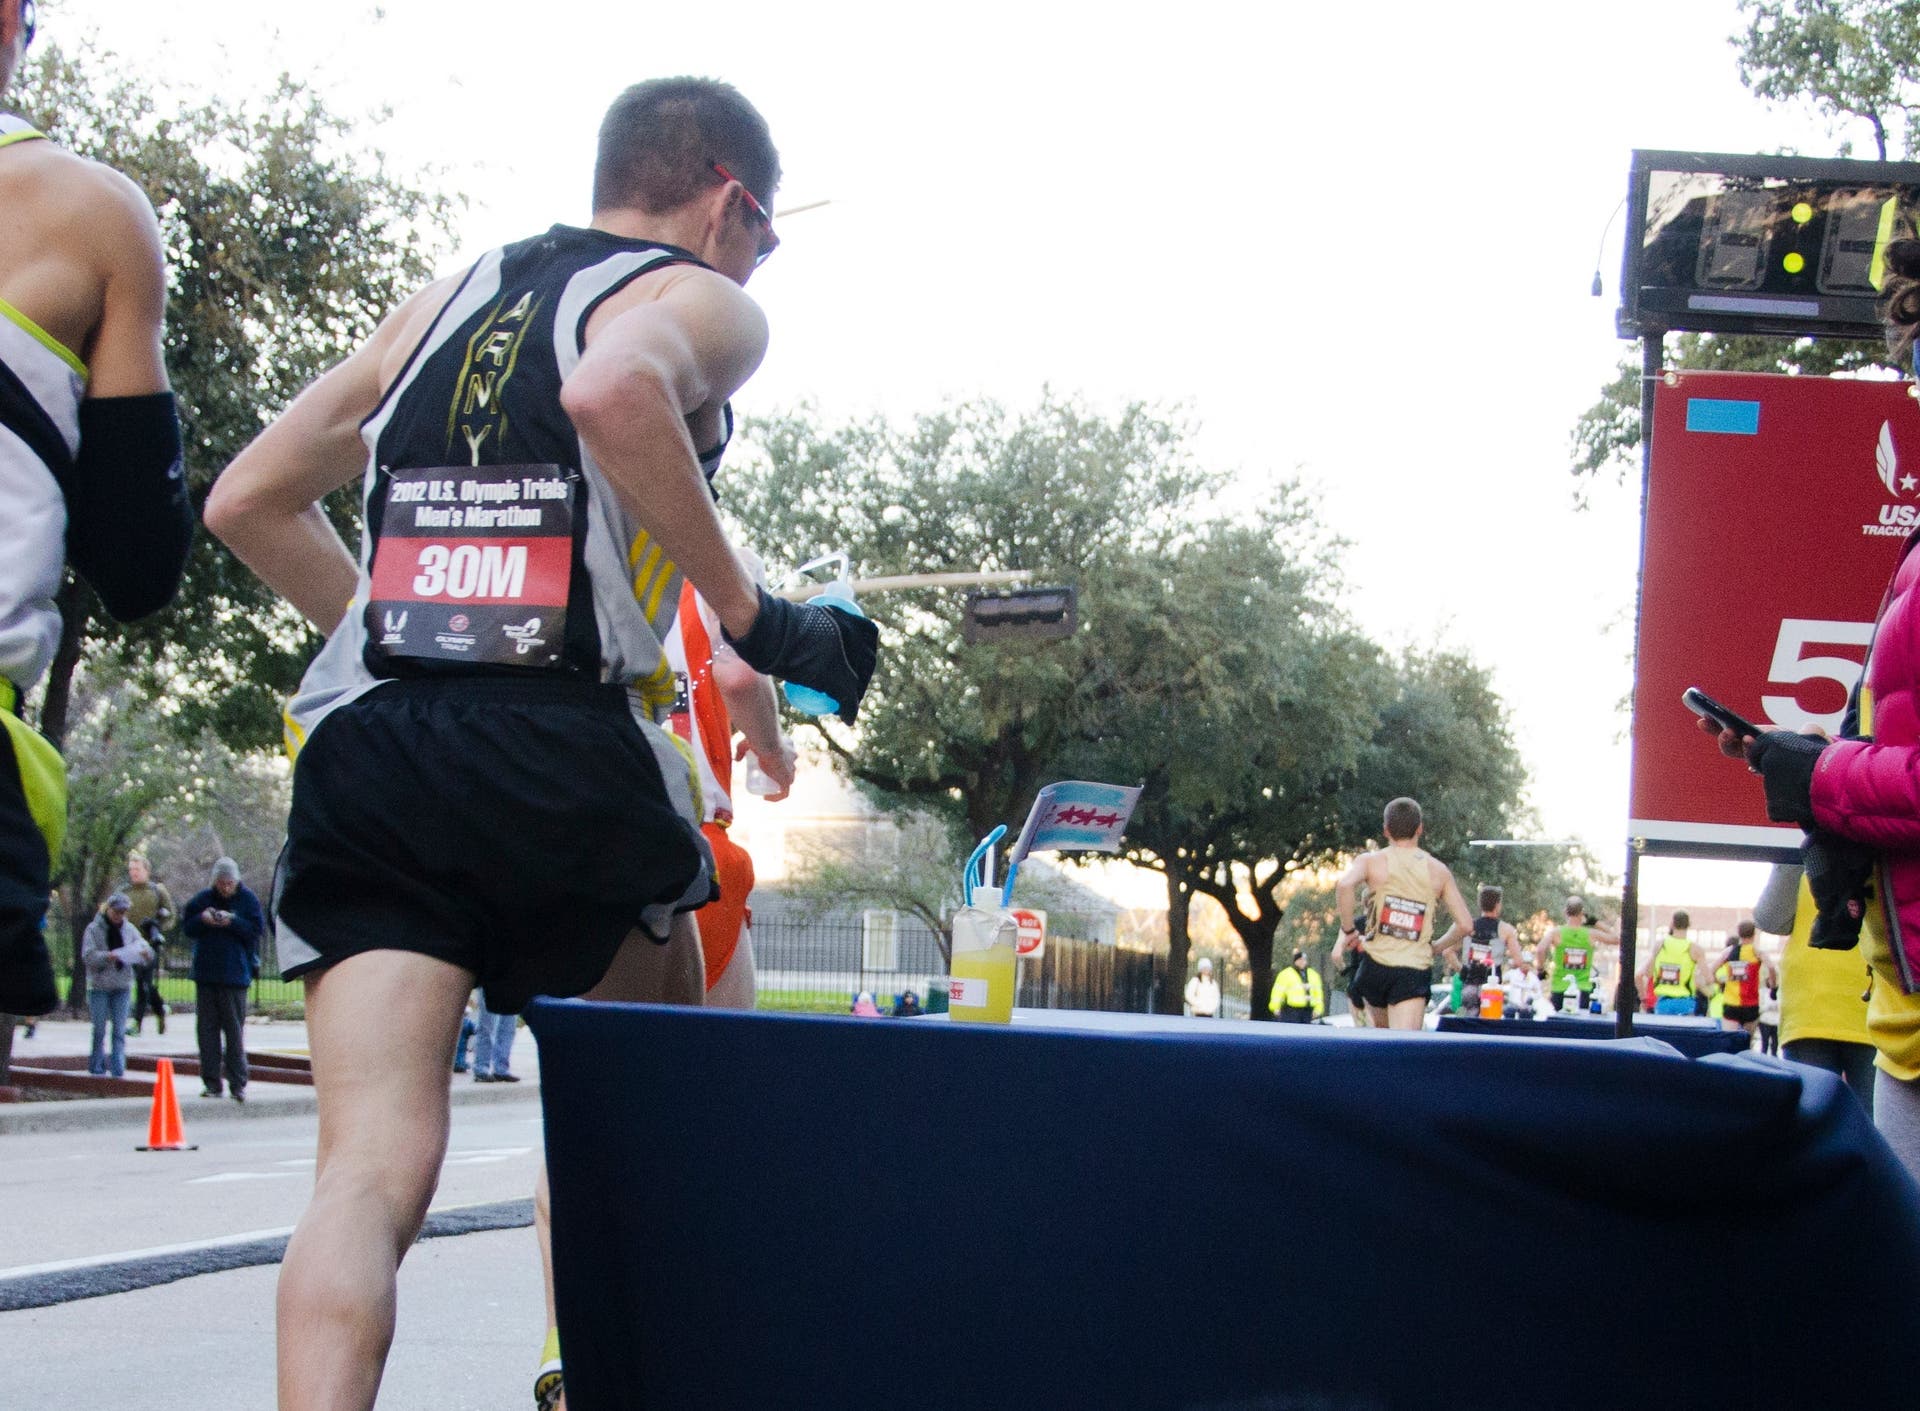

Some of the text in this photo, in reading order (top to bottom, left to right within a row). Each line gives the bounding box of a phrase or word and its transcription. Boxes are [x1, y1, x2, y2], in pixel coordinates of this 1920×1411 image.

[461, 290, 535, 467] ARMY
[390, 478, 568, 504] 2012 U.S. Olympic Trials
[415, 506, 542, 527] Men's Marathon
[412, 544, 528, 598] 30M
[1761, 618, 1876, 737] 5
